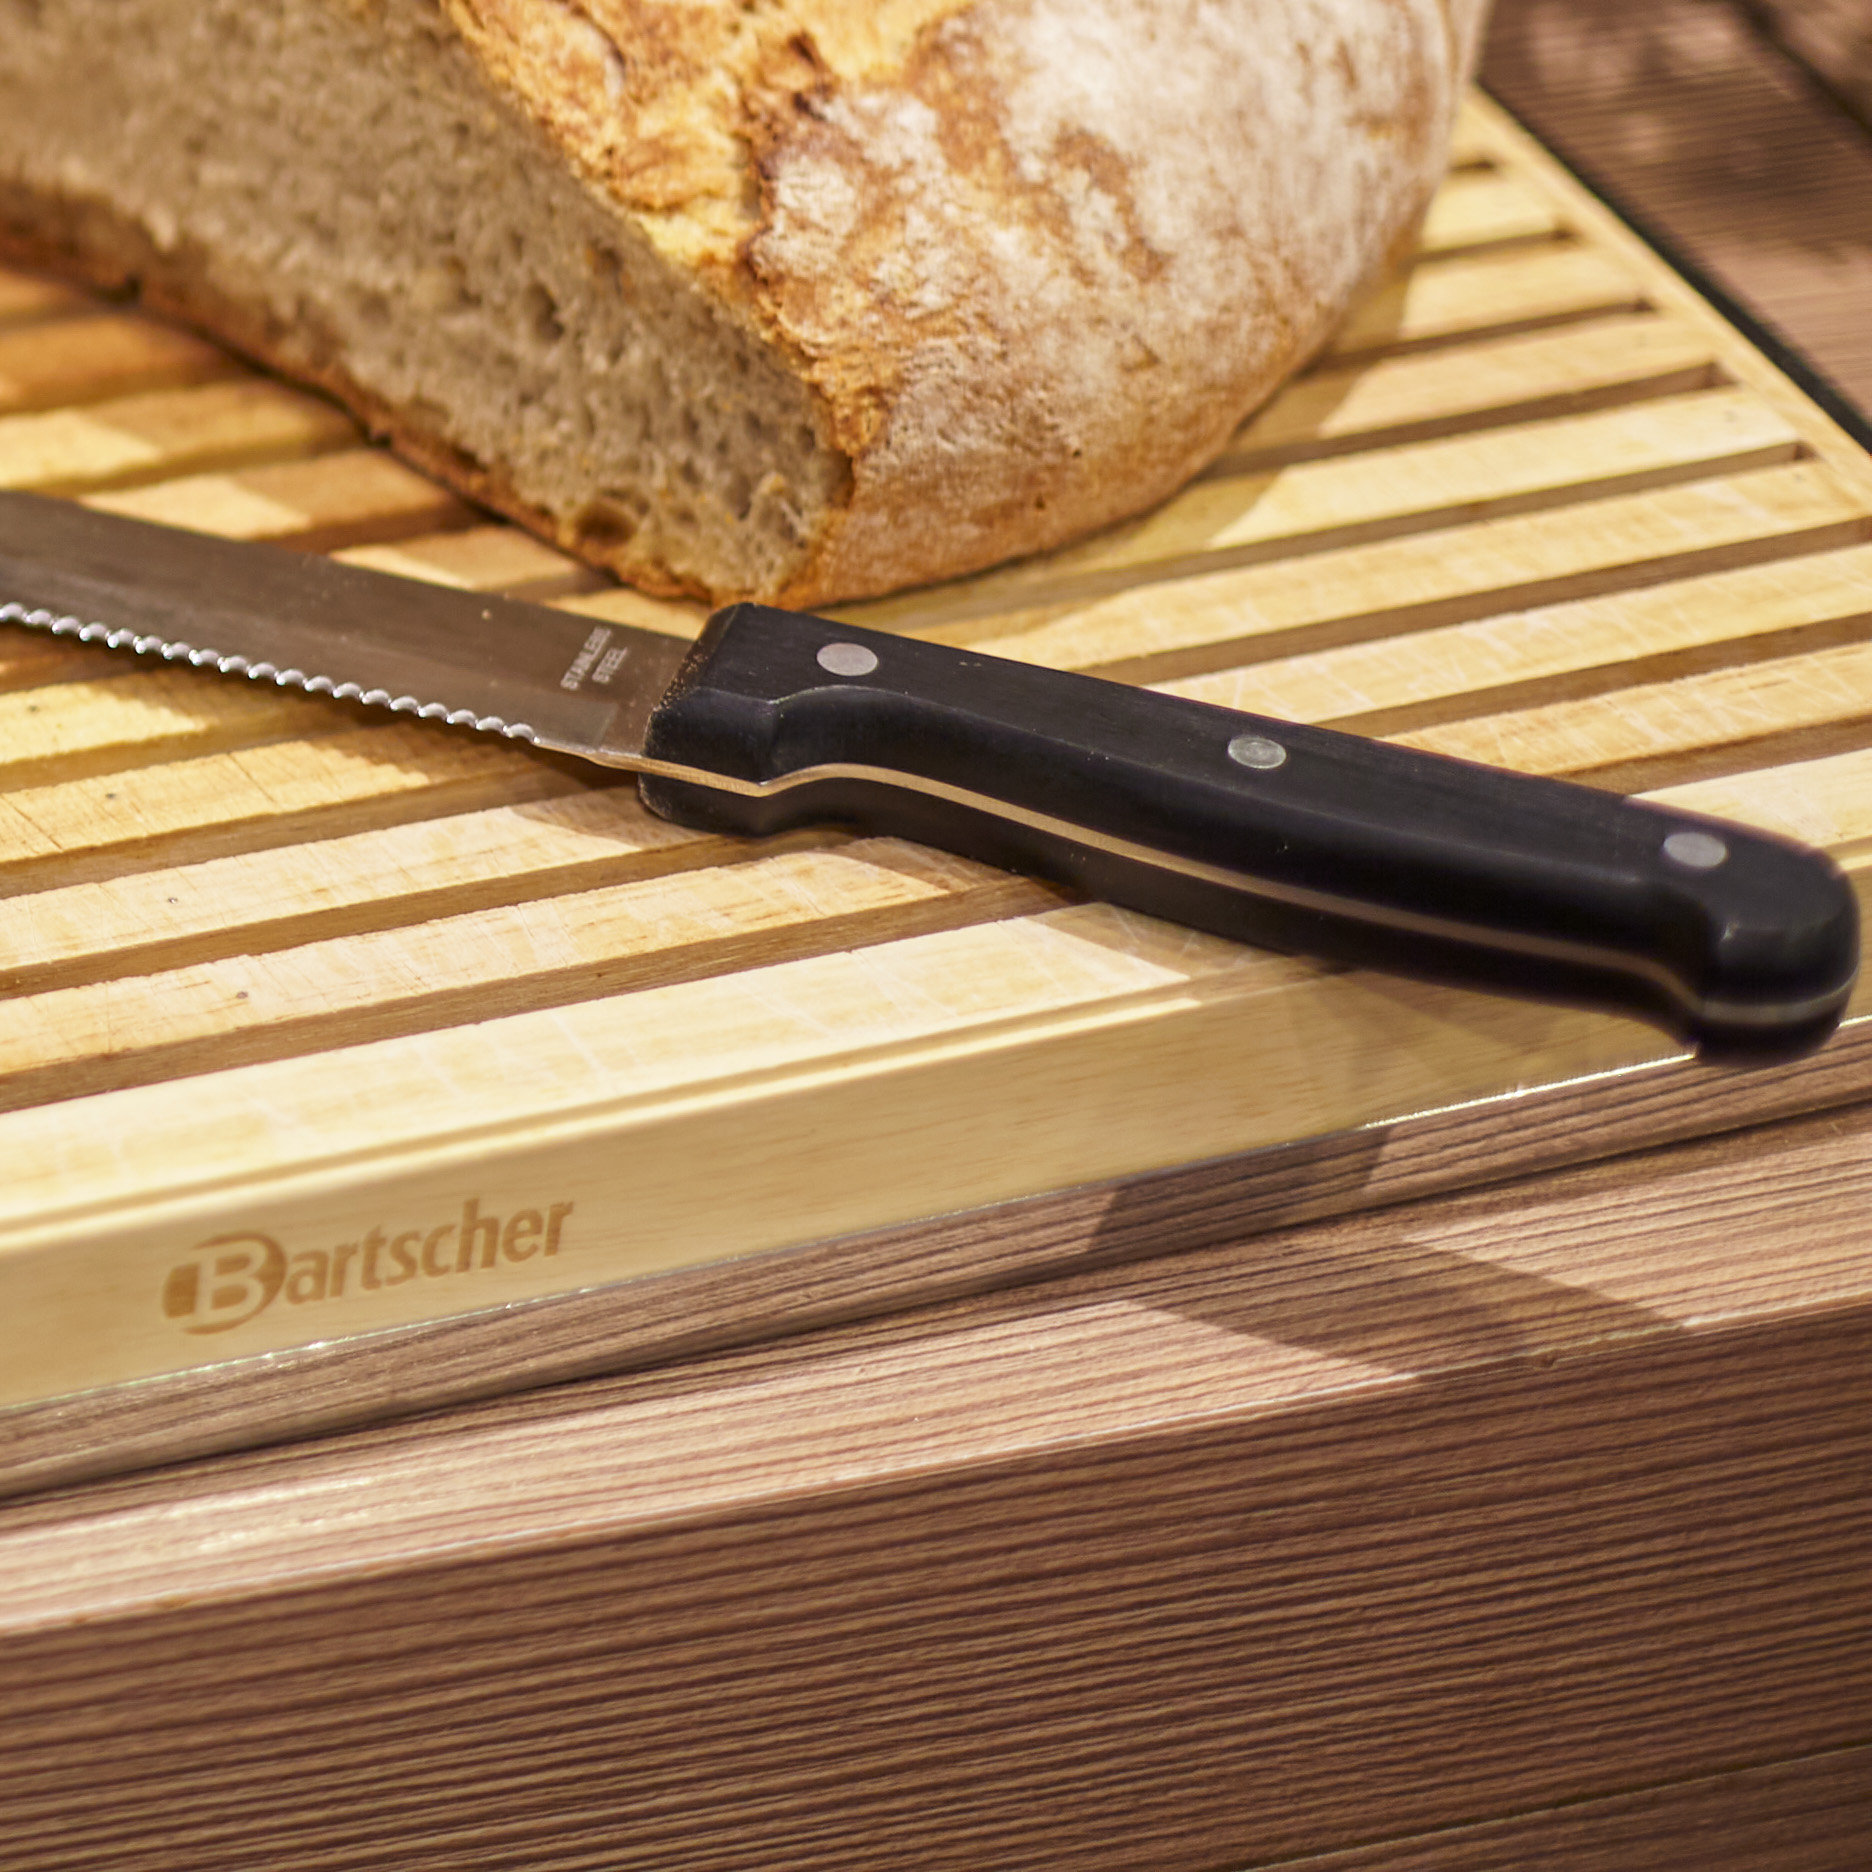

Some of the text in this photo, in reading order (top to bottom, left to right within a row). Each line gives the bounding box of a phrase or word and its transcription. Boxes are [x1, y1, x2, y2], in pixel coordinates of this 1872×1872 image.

[560, 626, 613, 691] STAINLESS
[592, 646, 628, 683] STEEL
[161, 1196, 574, 1336] Bartscher
